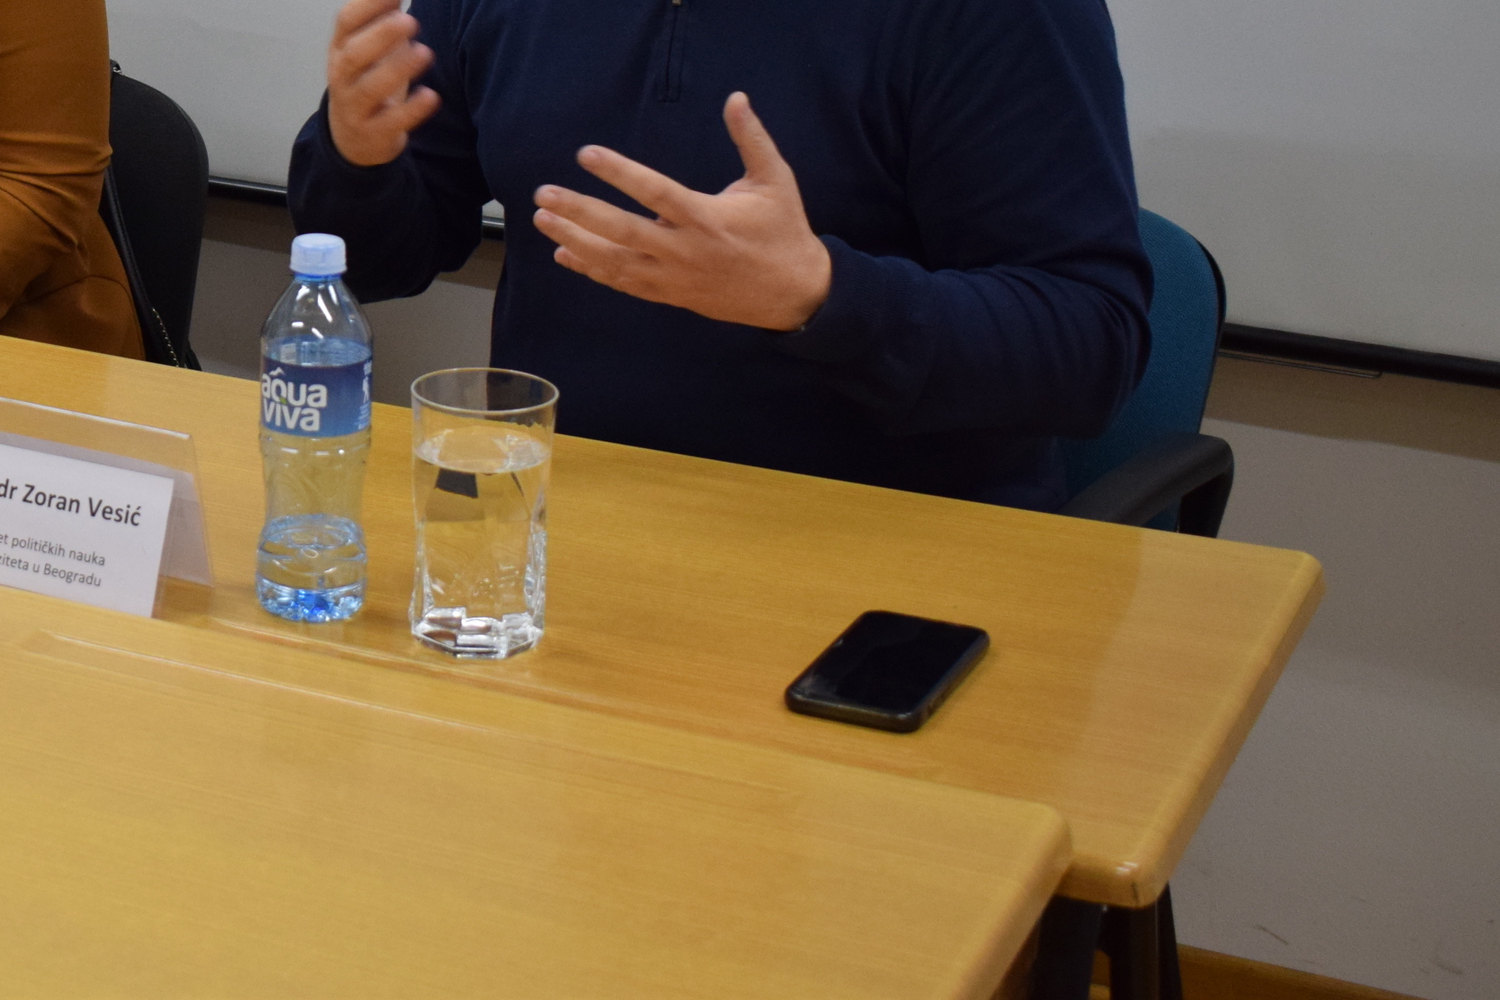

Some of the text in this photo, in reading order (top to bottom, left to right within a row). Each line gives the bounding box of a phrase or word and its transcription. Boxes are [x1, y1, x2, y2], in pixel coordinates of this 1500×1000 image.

[261, 371, 328, 408] aqua
[263, 398, 320, 432] viva
[21, 484, 81, 514] Zoran
[88, 497, 141, 527] Vesić
[11, 536, 66, 558] političkih
[68, 550, 106, 567] nauka
[32, 564, 40, 574] u
[43, 562, 102, 588] Beogradu
